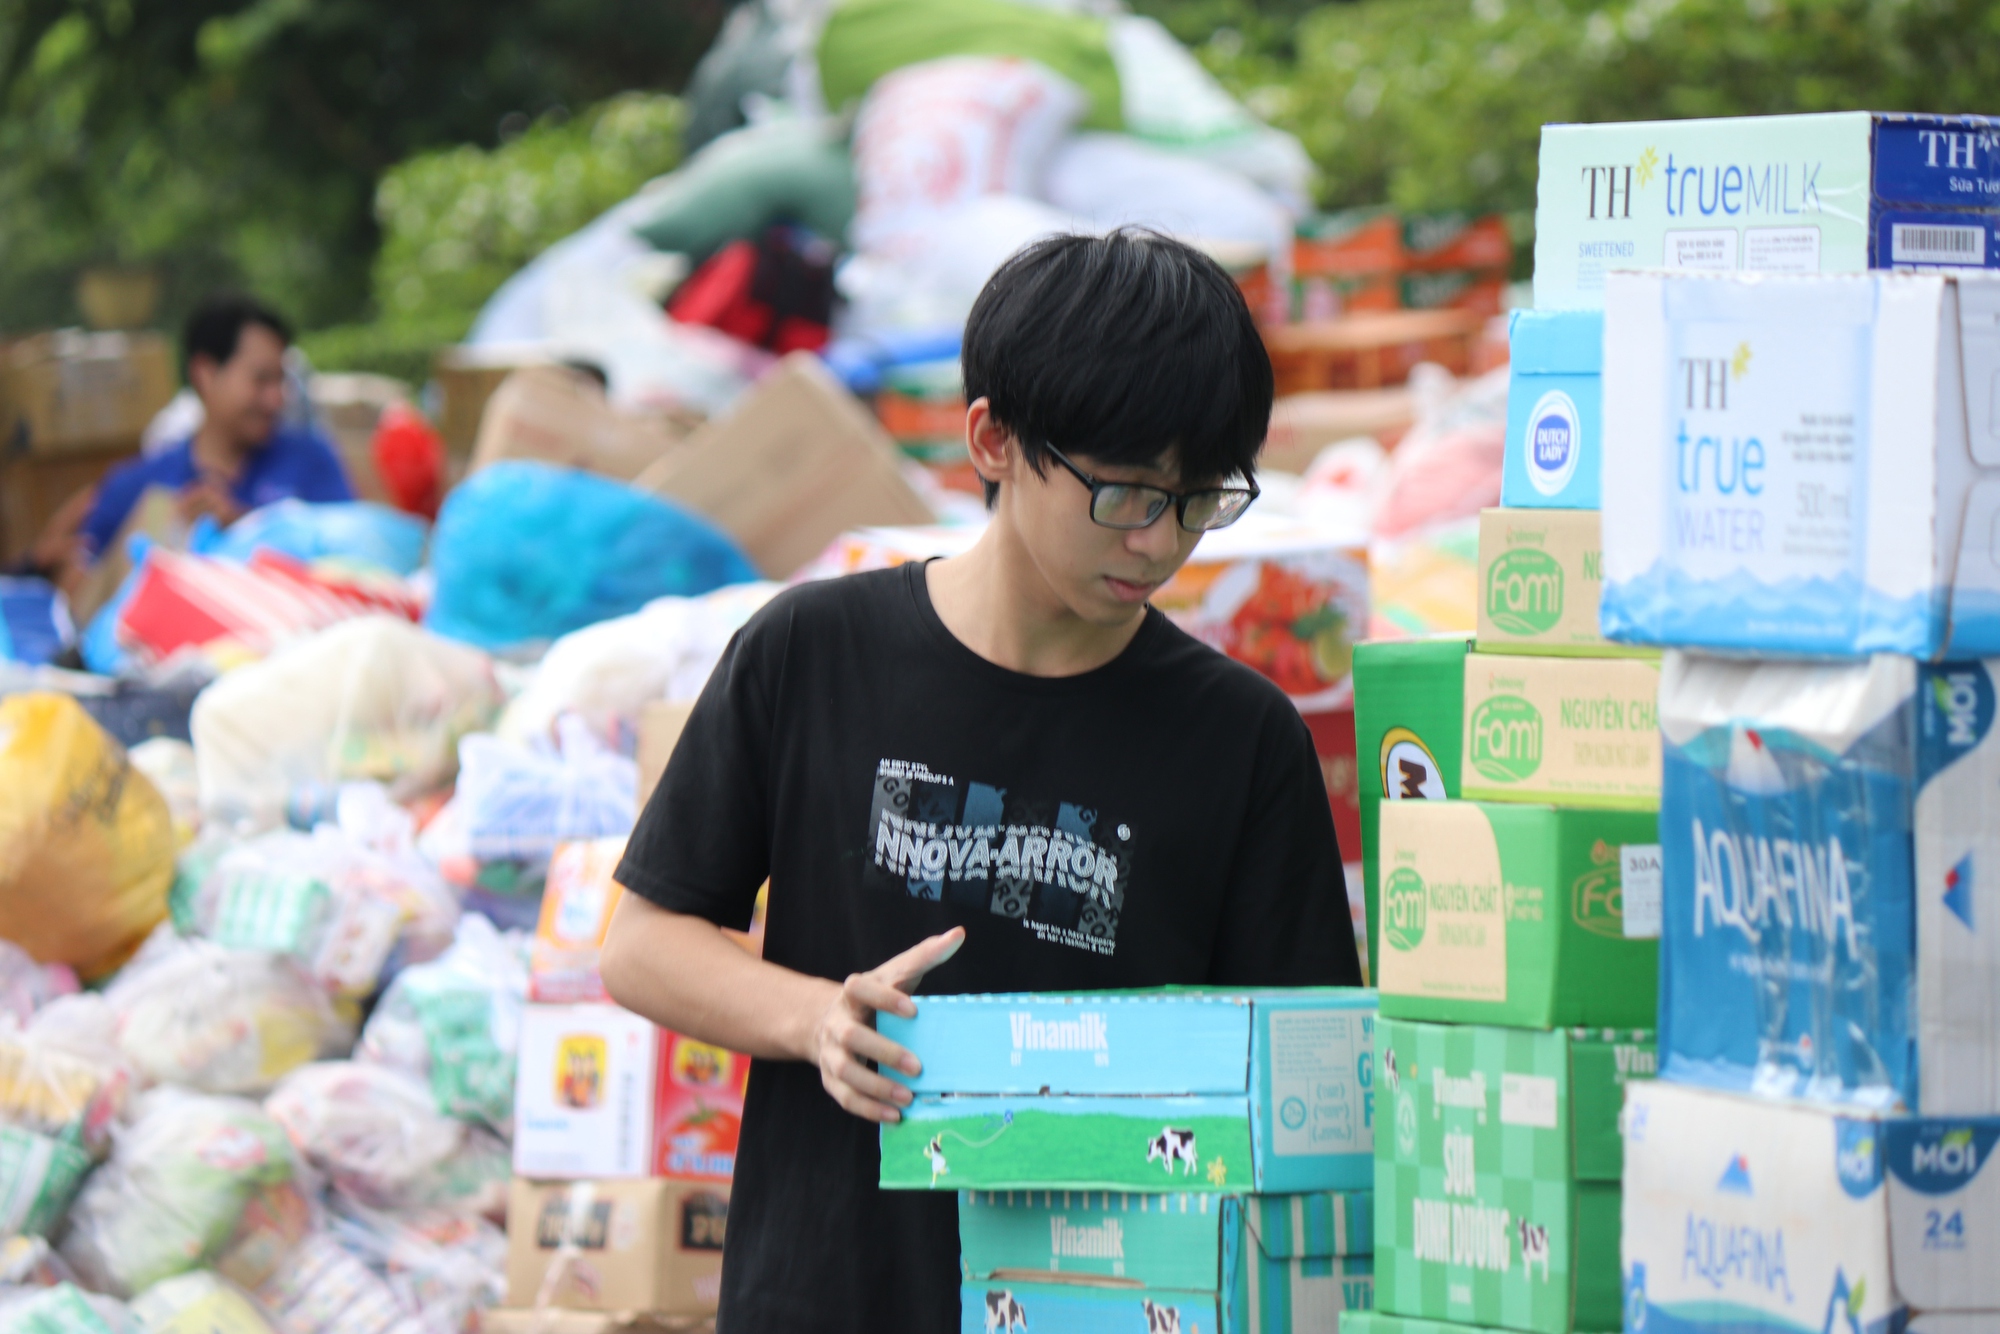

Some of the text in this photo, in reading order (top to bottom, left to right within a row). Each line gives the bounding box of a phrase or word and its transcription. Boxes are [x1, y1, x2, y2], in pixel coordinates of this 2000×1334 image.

[1919, 130, 1976, 169] TH
[1582, 166, 1635, 219] TH
[1579, 240, 1634, 258] SWEETENED
[1679, 358, 1728, 410] TH
[1537, 427, 1569, 446] DUTCH
[1540, 444, 1563, 461] LADY
[1676, 419, 1765, 495] true
[1675, 508, 1765, 551] WATER
[1693, 817, 1861, 960] AQUAFINA
[1009, 1011, 1108, 1051] Vinamilk
[1614, 1044, 1655, 1073] Vin
[1050, 1215, 1124, 1259] Vinamilk
[1924, 1210, 1965, 1238] 24
[1683, 1211, 1795, 1304] AQUAFINA
